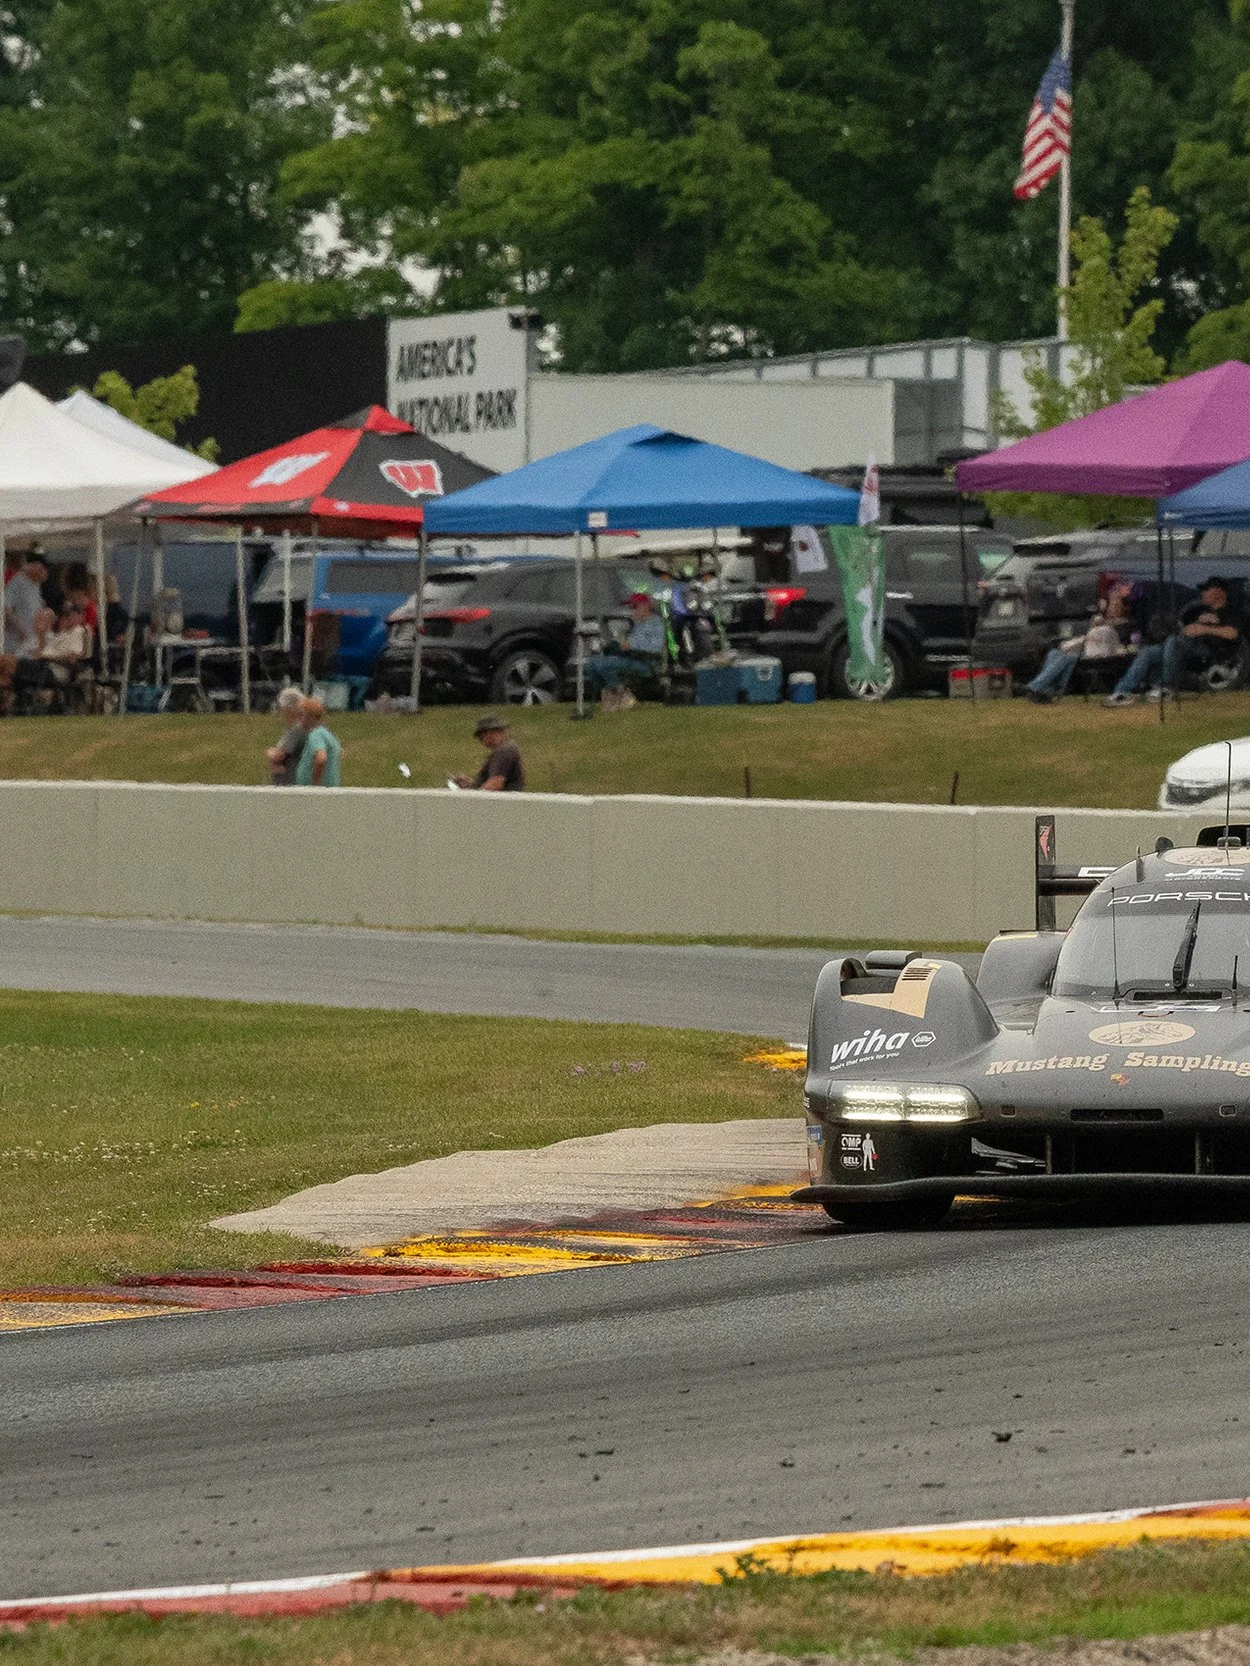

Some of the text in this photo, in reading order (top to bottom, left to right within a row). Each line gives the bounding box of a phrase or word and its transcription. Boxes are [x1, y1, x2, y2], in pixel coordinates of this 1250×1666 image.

[397, 334, 477, 383] AMERICA'S
[476, 387, 517, 430] PARK
[831, 1028, 911, 1064] wiha
[985, 1053, 1110, 1076] Mustang
[841, 1136, 862, 1147] OMP
[843, 1156, 860, 1164] BELL
